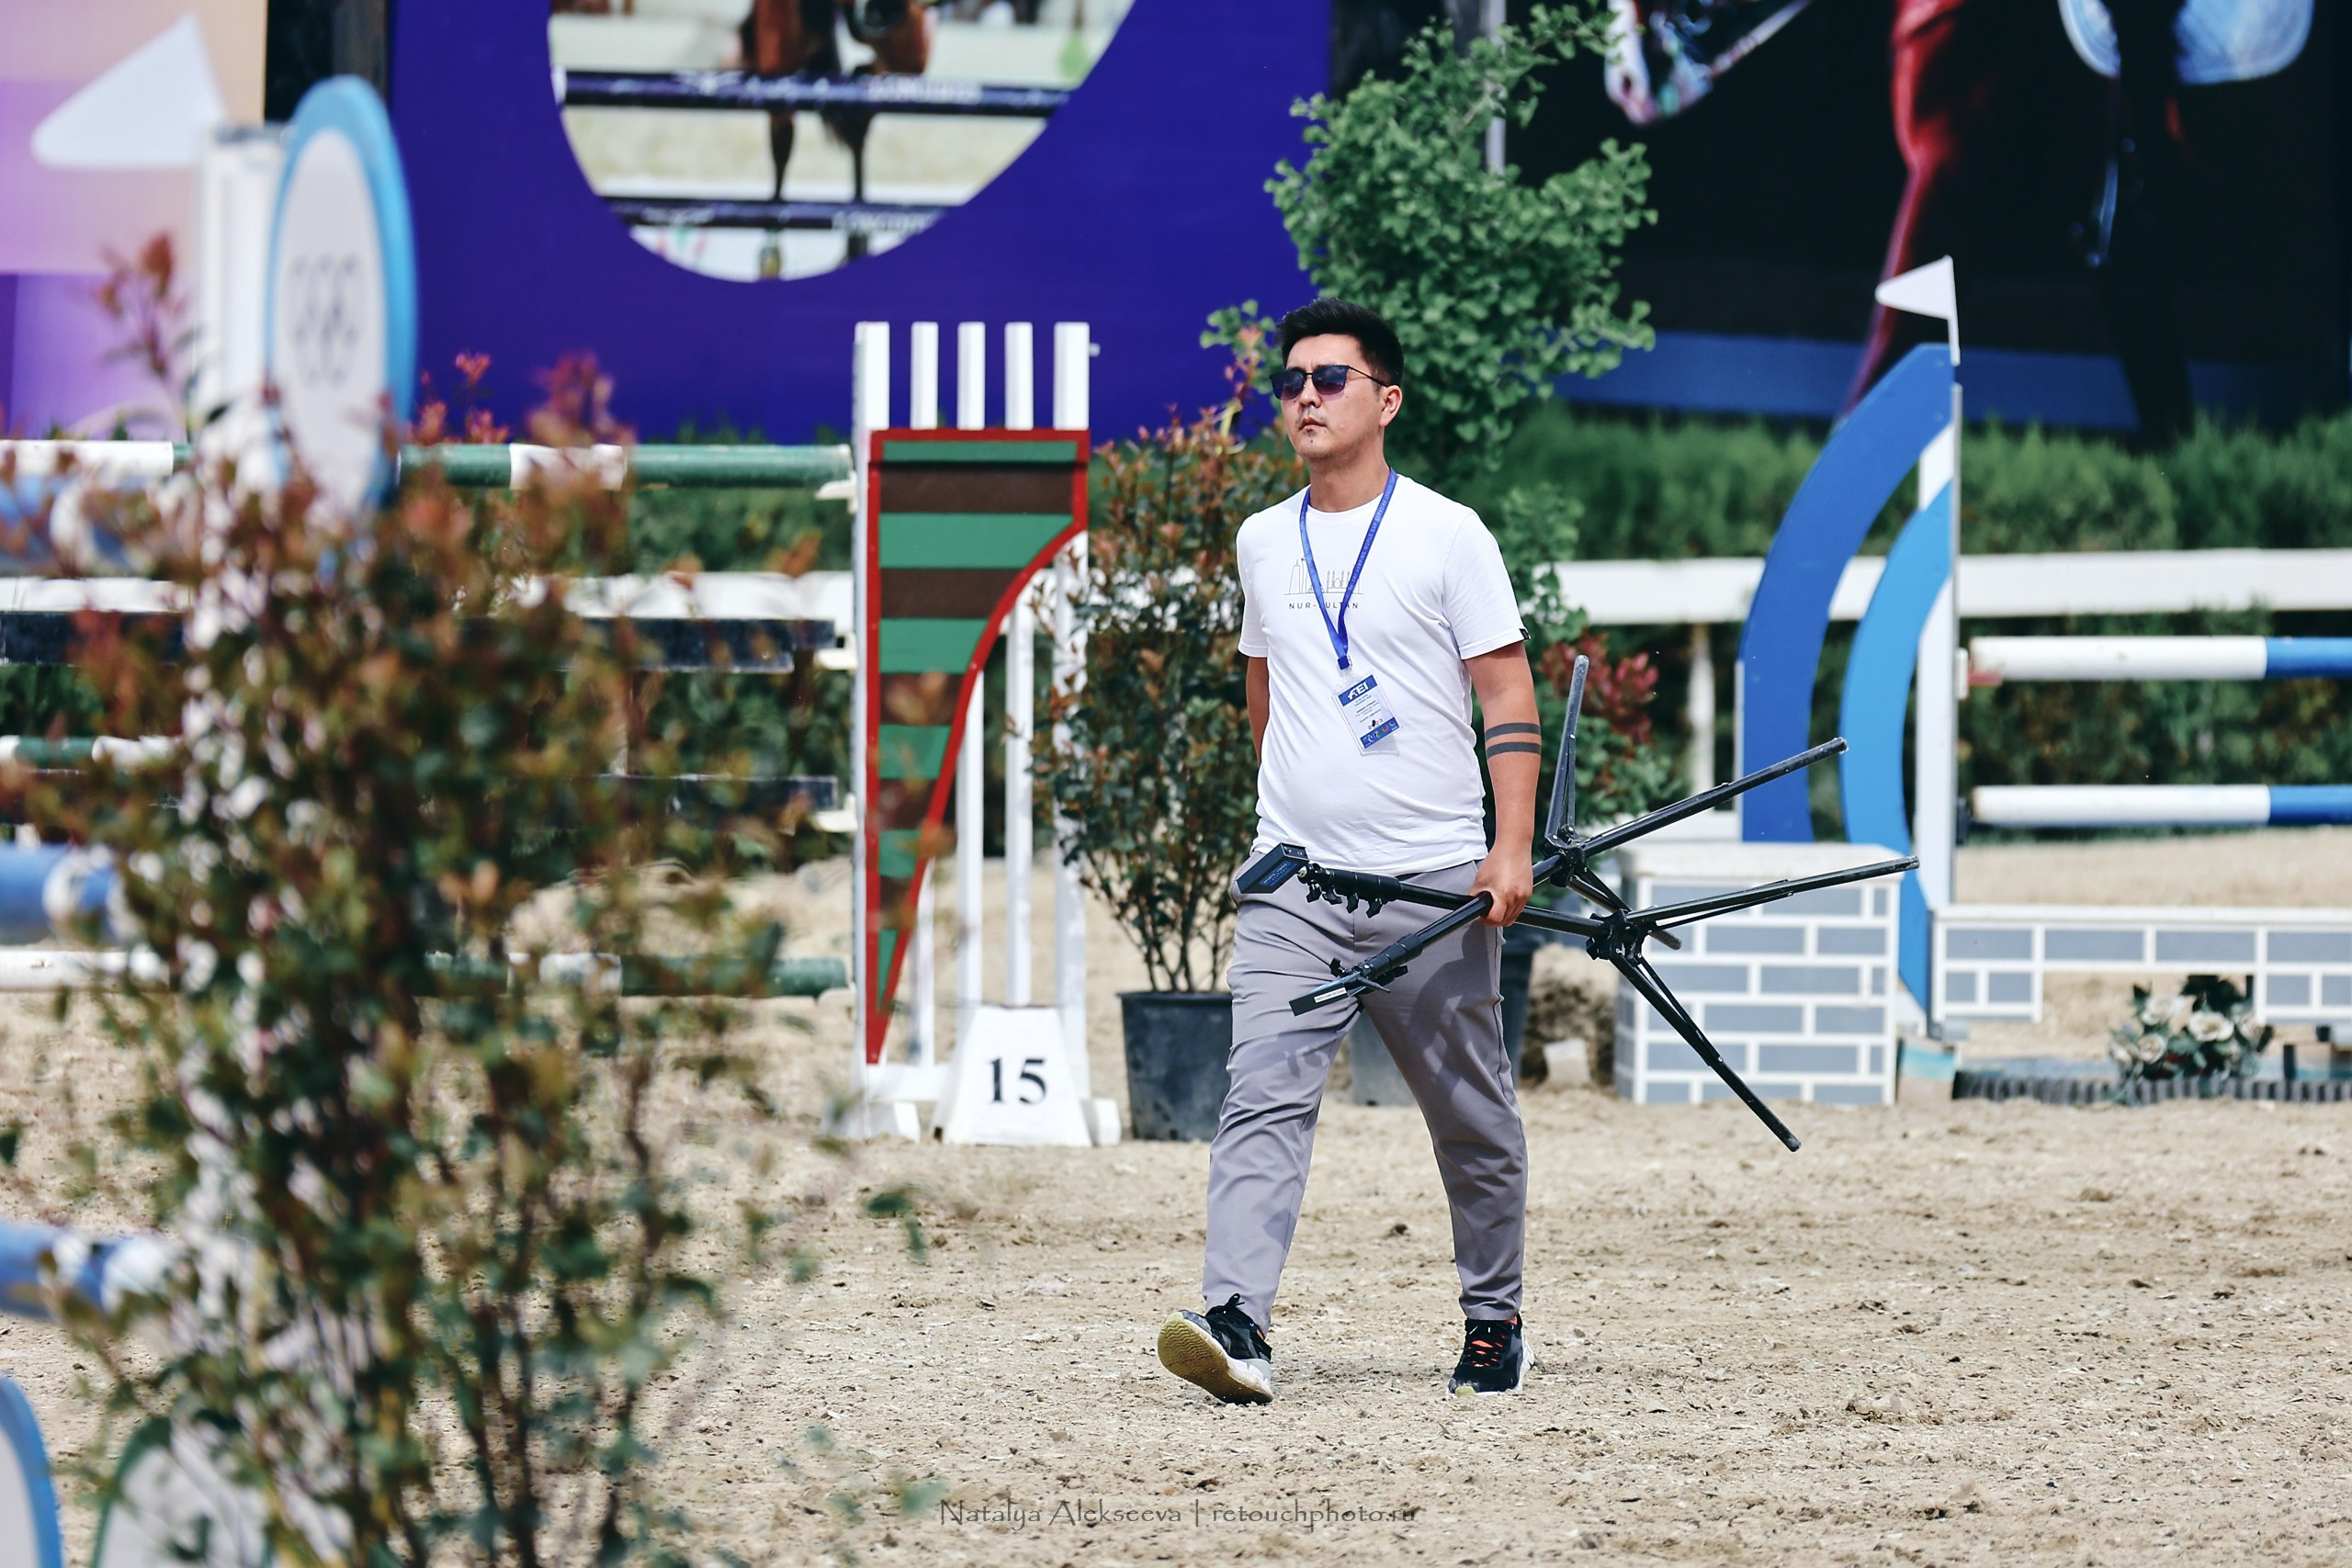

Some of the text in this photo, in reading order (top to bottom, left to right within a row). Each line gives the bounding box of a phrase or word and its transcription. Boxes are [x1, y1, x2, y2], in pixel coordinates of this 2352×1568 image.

[1363, 532, 1374, 550] WORLD
[1369, 521, 1378, 532] CUP
[1347, 682, 1369, 700] FEI
[988, 1057, 1046, 1105] 15
